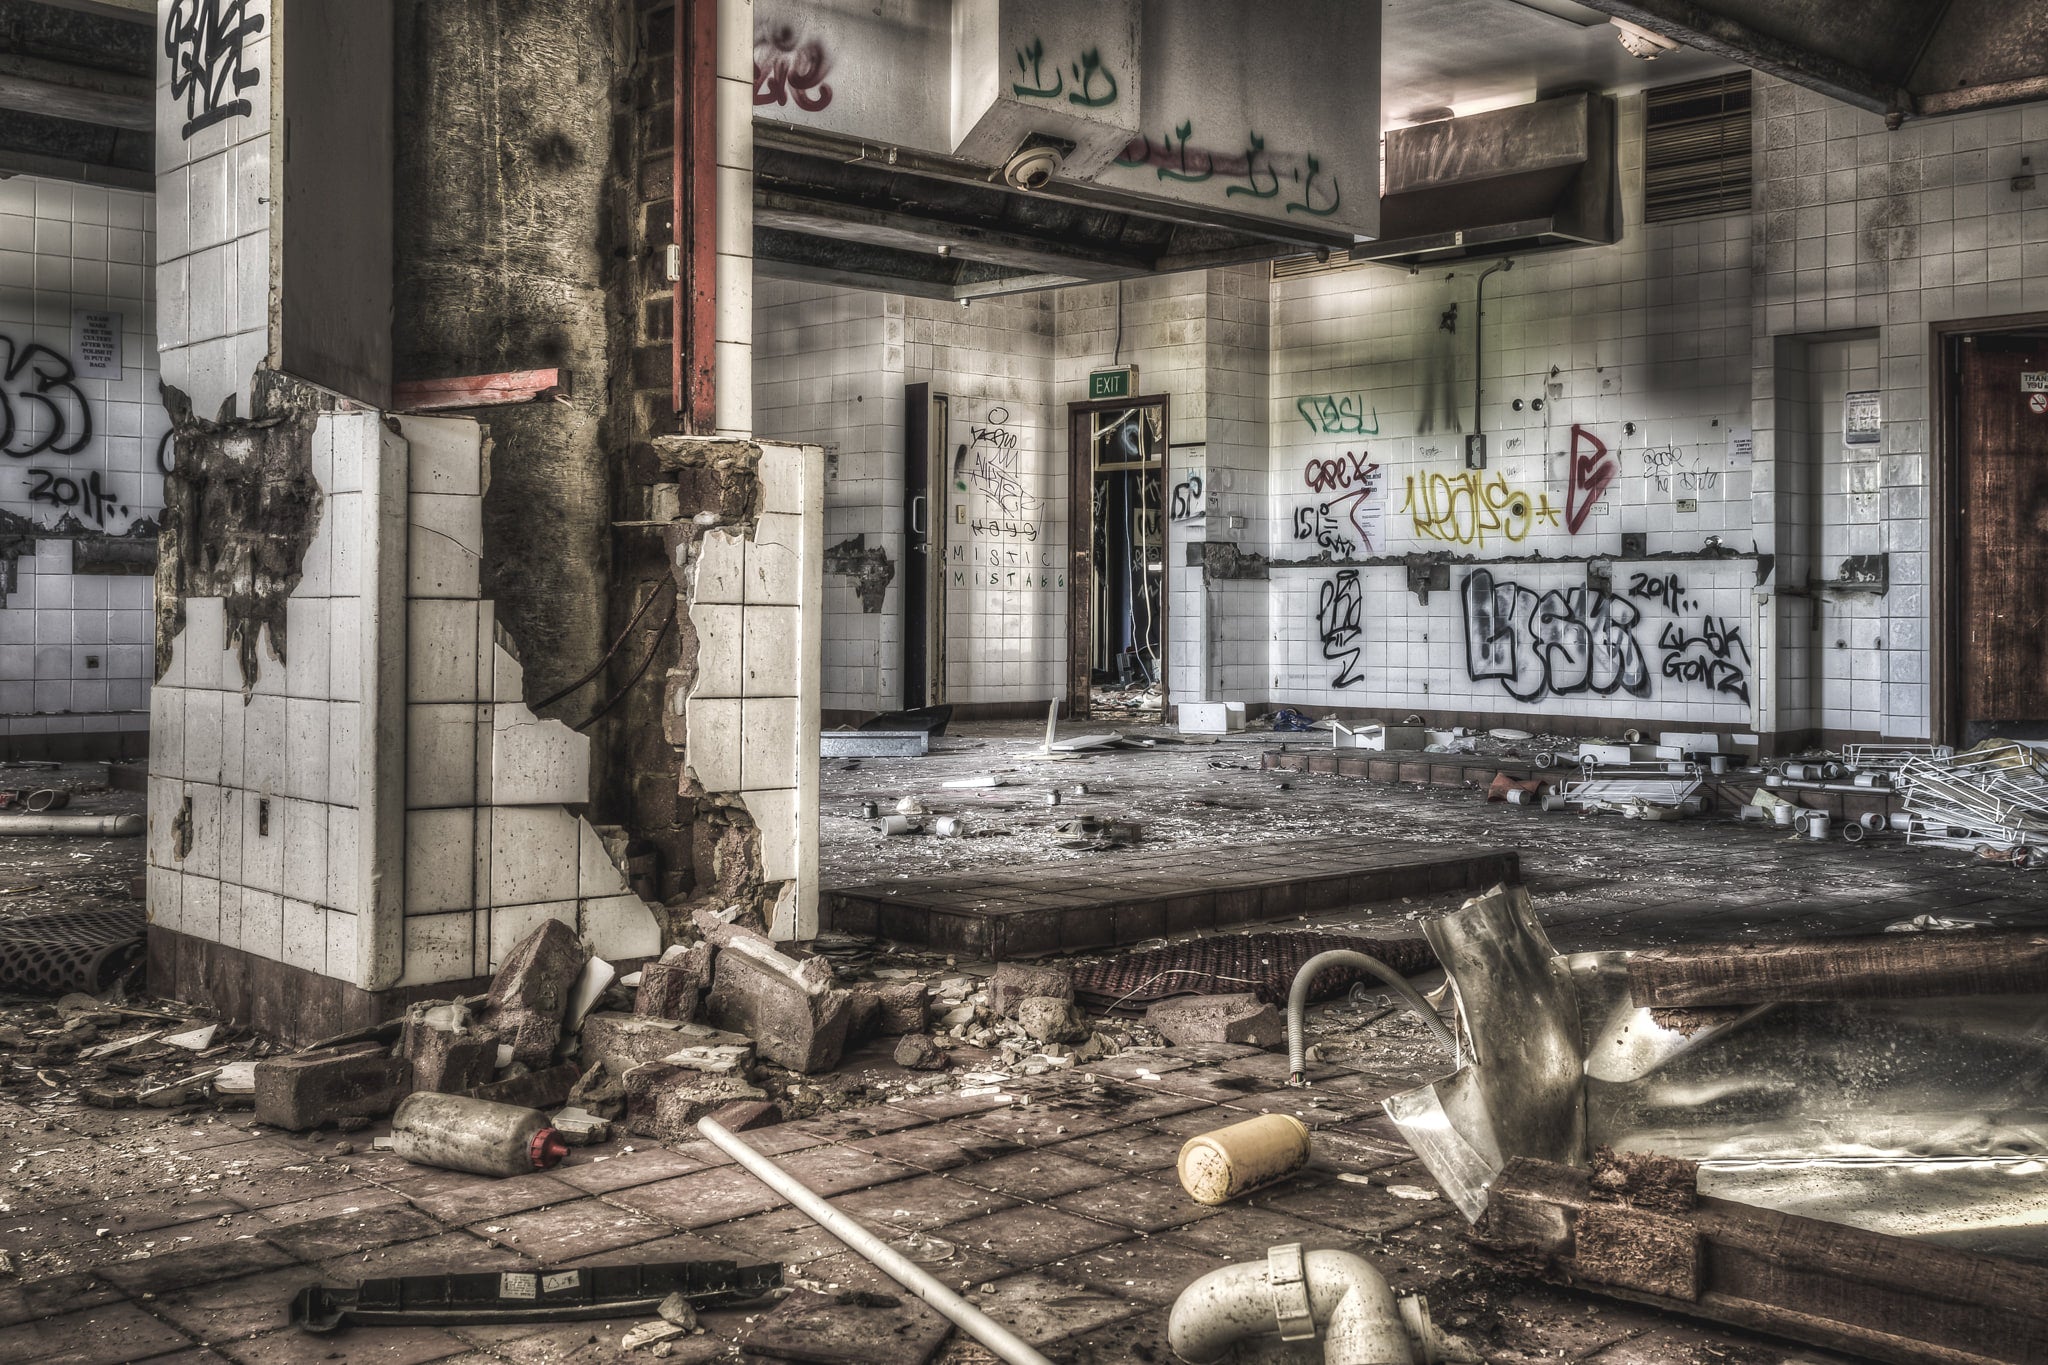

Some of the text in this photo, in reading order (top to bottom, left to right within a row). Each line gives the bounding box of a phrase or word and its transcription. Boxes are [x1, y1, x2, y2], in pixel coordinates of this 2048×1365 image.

[2024, 374, 2048, 382] THAN
[1096, 376, 1120, 394] EXIT
[2026, 381, 2043, 389] YOU
[953, 545, 1051, 567] MISTIC
